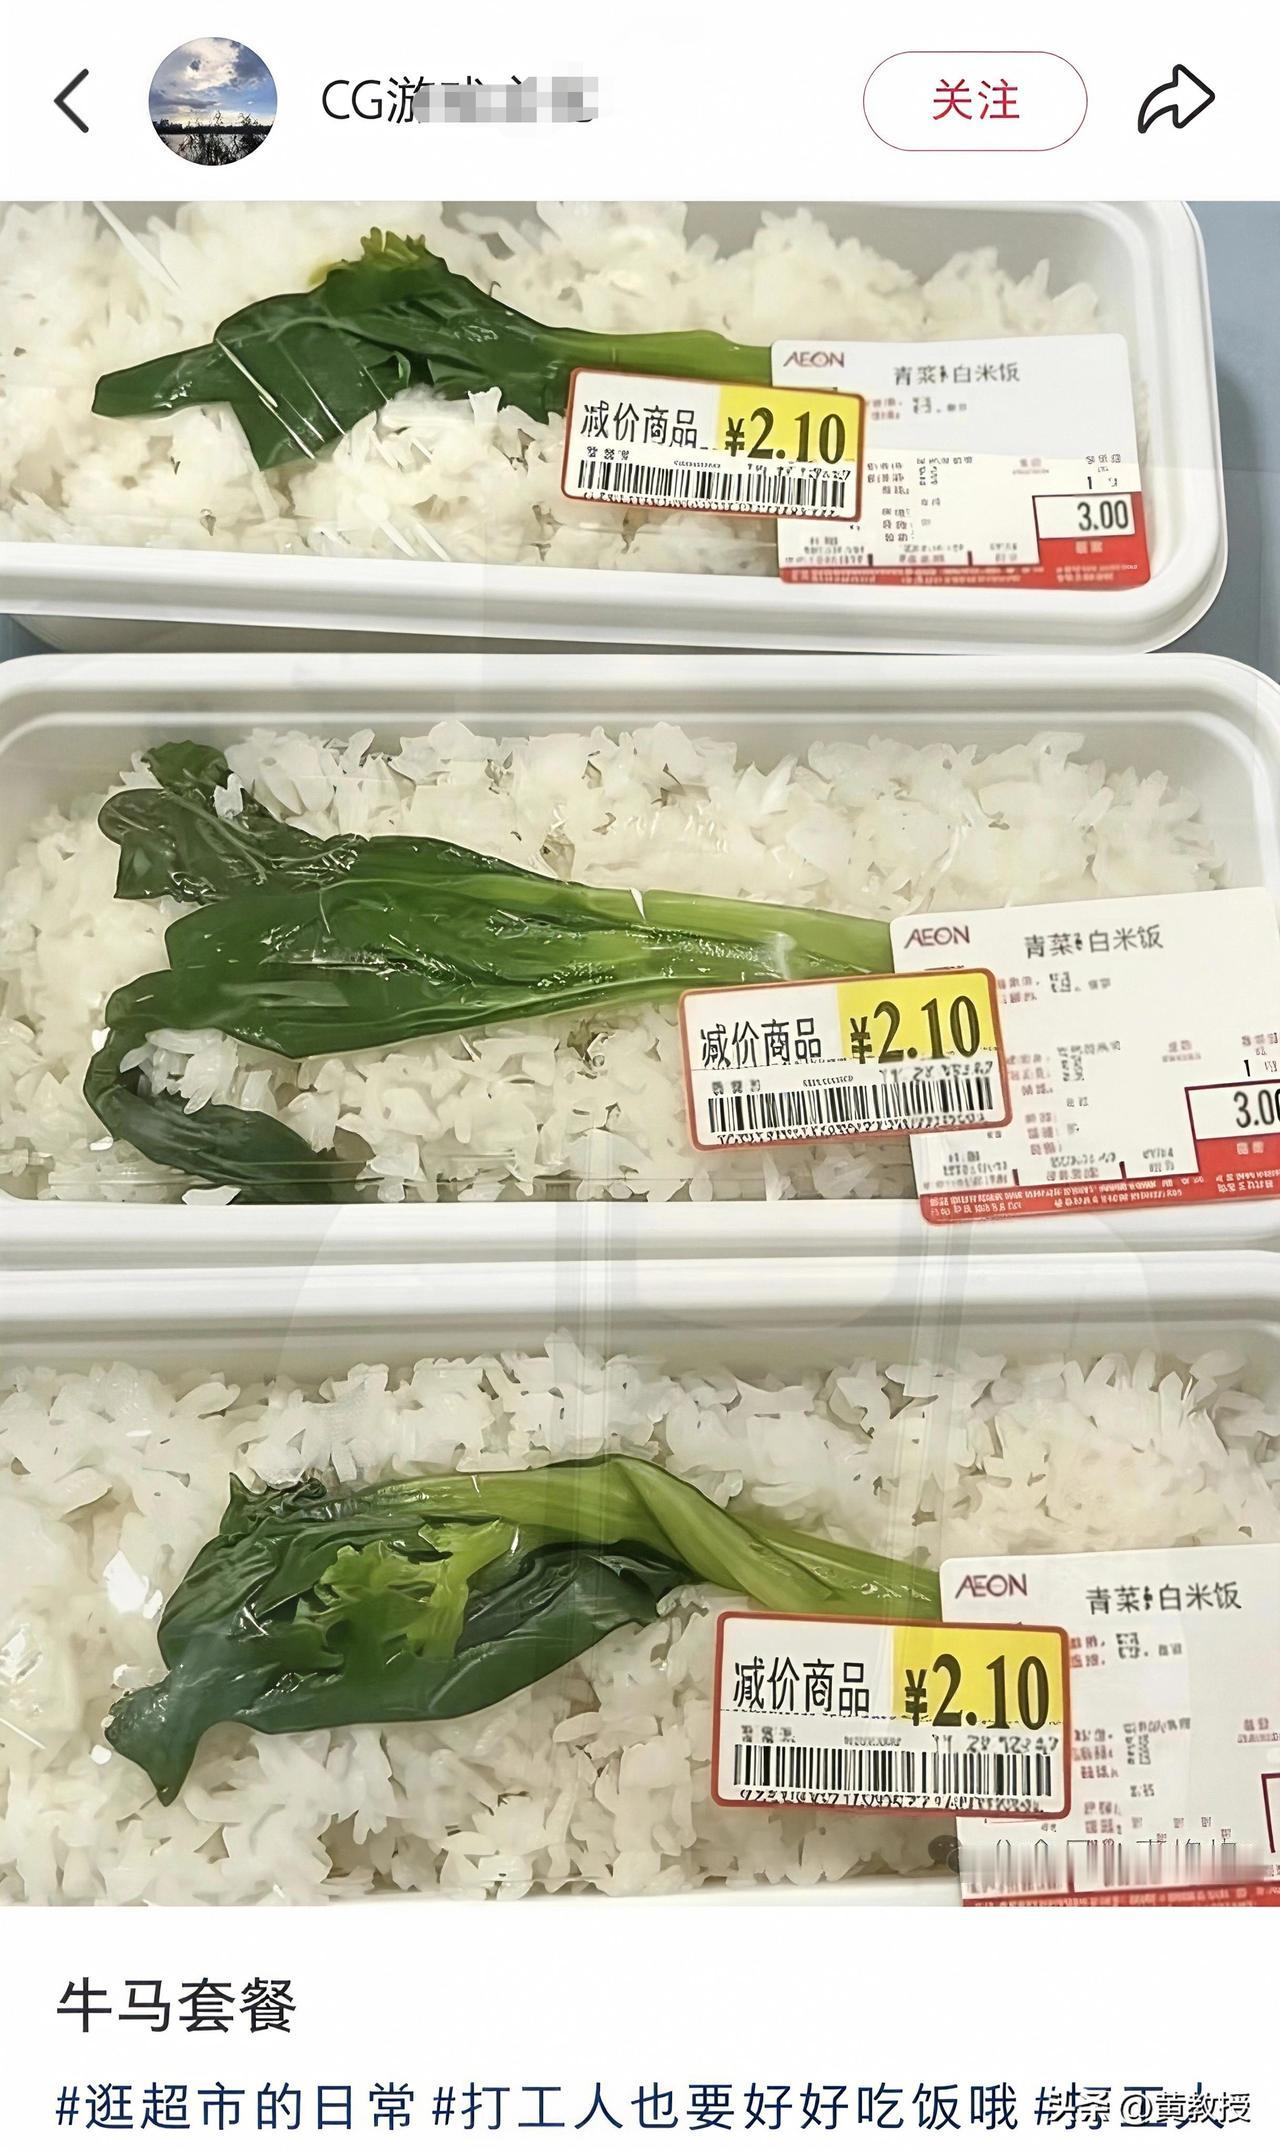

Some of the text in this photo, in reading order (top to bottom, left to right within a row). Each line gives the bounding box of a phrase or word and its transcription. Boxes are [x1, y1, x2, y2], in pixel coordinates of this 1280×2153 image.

[783, 351, 845, 368] AEON
[580, 400, 846, 464] 减价商品 ¥2.10
[1077, 500, 1129, 531] 3.00
[904, 925, 971, 949] AEON
[700, 994, 981, 1067] 减价商品 ¥2.10
[955, 1573, 1028, 1599] AEON
[733, 1653, 1050, 1731] 减价商品 ¥2.10
